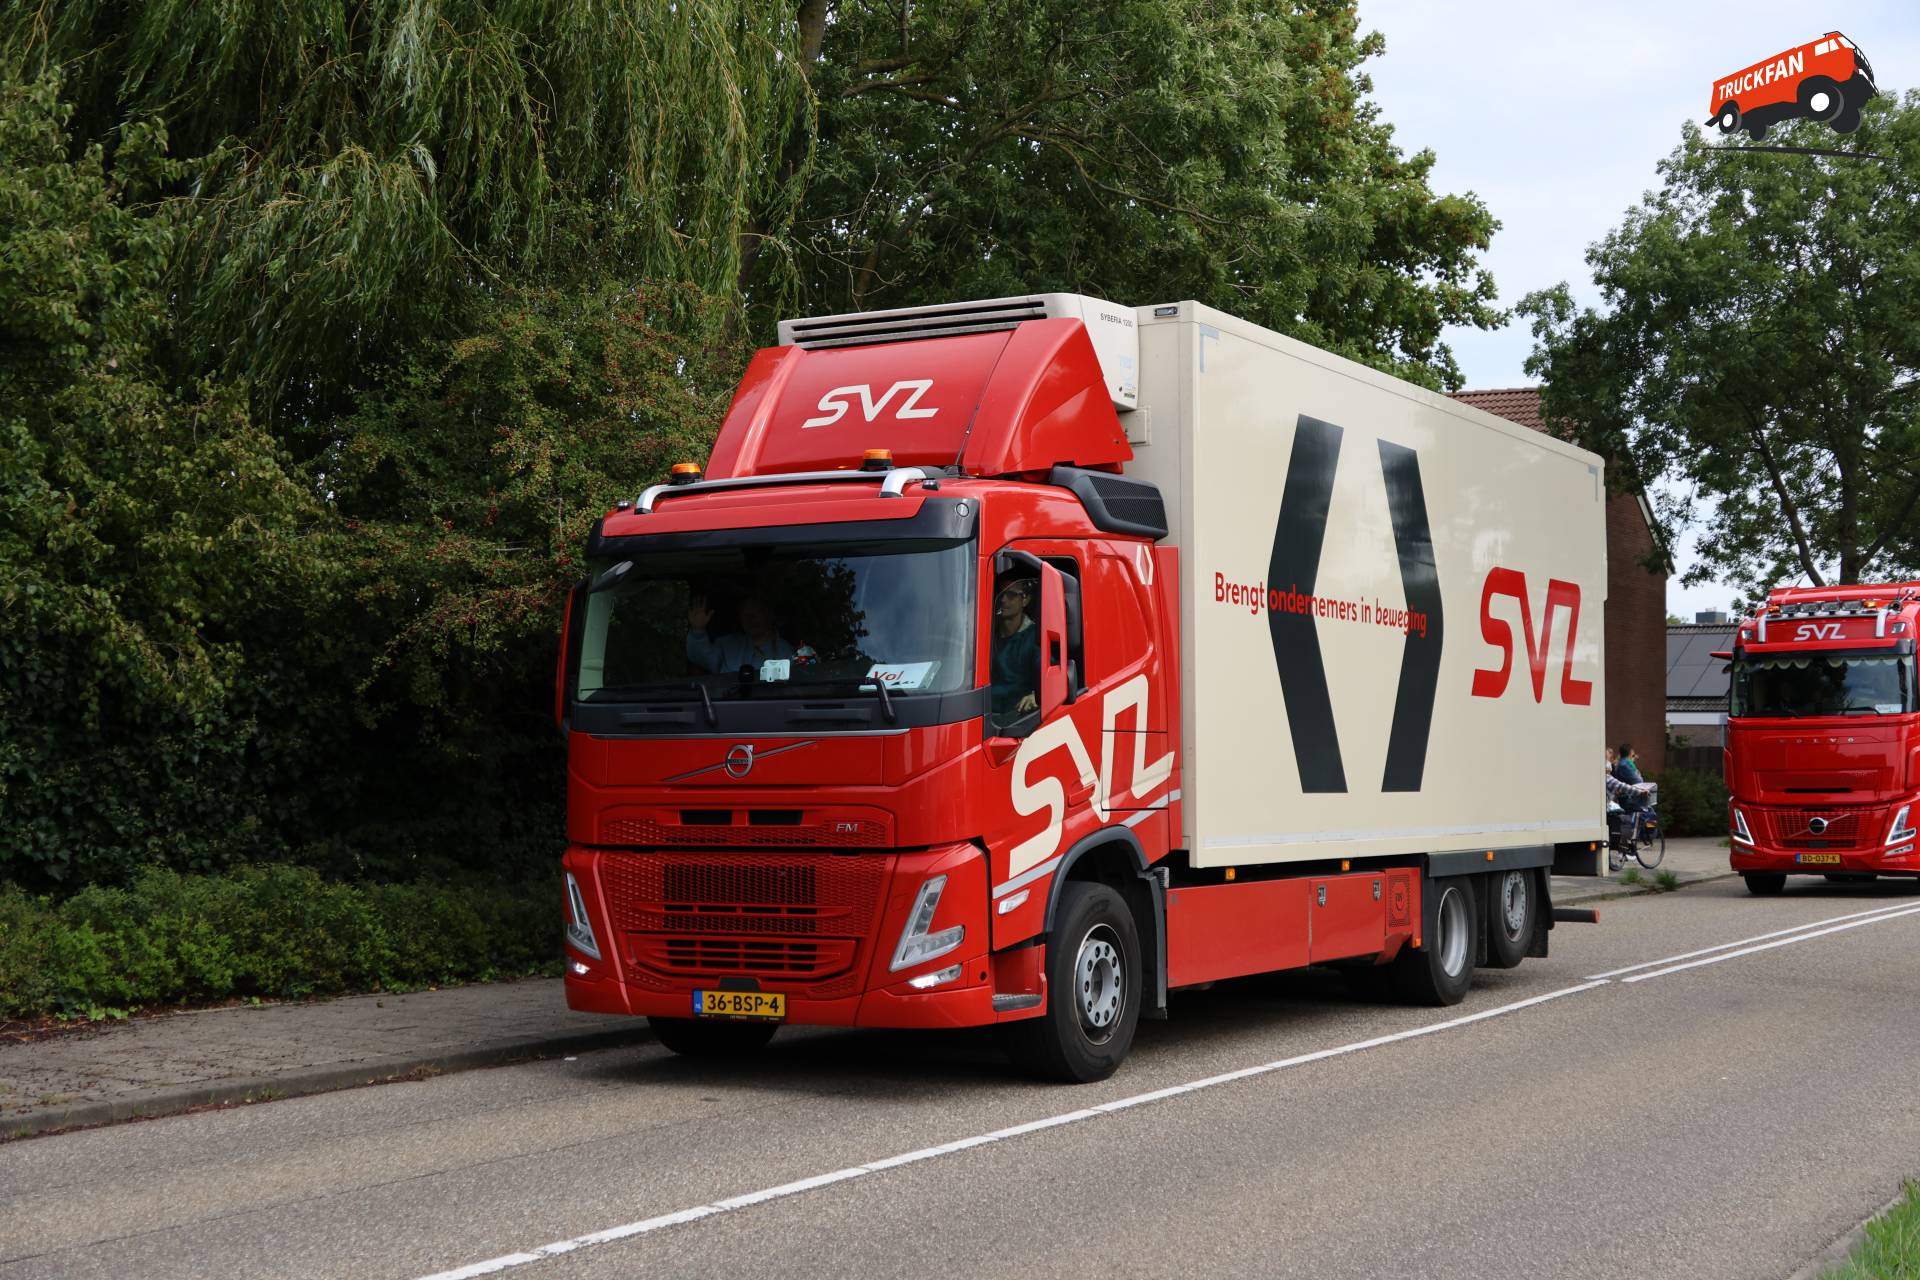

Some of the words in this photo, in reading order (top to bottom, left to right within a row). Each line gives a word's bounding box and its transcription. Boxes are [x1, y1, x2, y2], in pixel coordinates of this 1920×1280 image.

[801, 379, 939, 429] SVZ
[1215, 571, 1265, 615] Brengt
[1268, 584, 1358, 622] ondernemers
[1361, 596, 1372, 624] in
[1375, 598, 1427, 638] beweging
[1471, 566, 1593, 706] SVZ
[1793, 623, 1847, 641] SVZ
[1008, 673, 1175, 880] SVZ
[835, 823, 859, 833] FM
[707, 994, 780, 1013] 36-BSP-4
